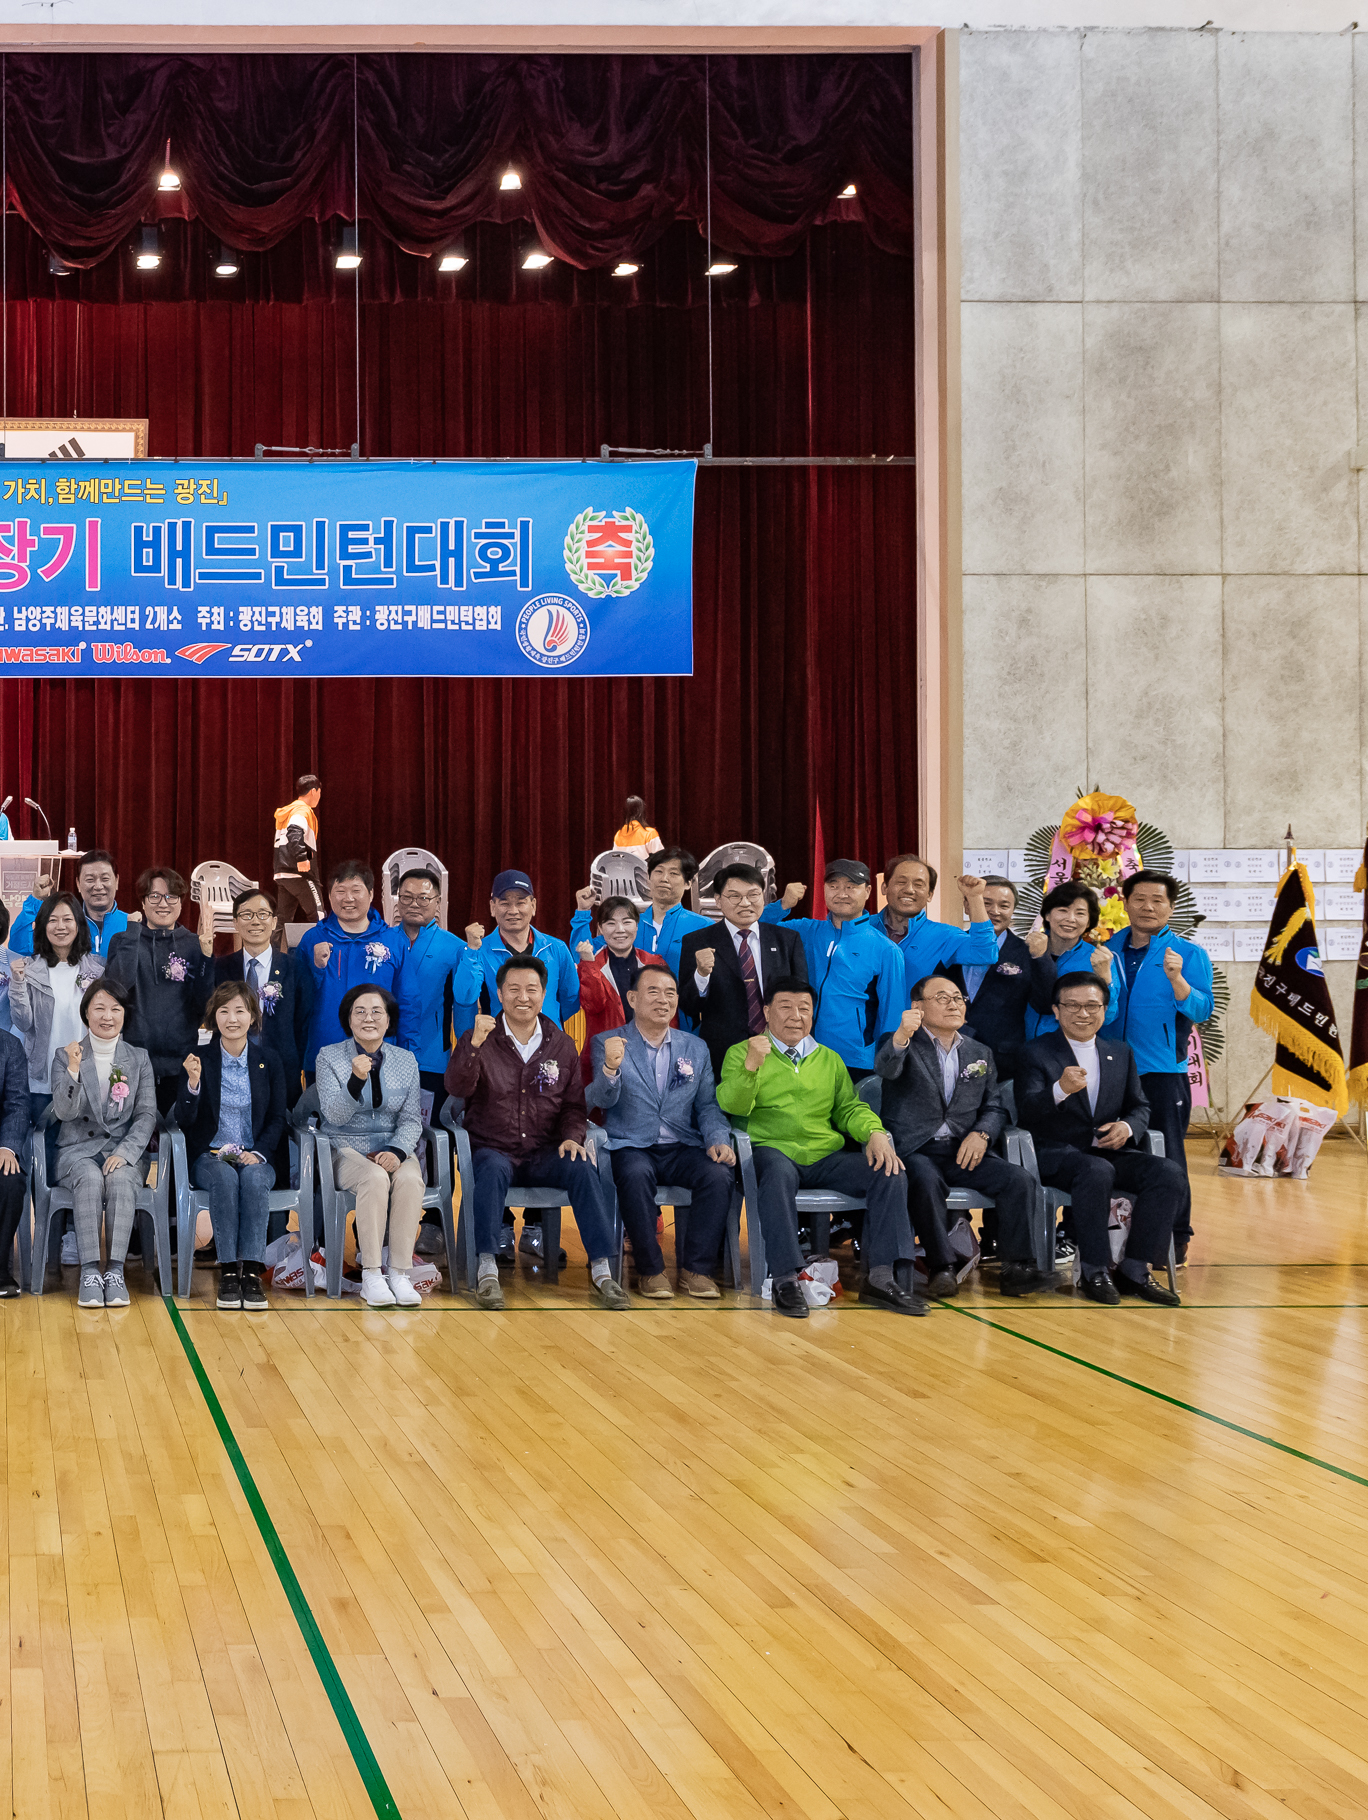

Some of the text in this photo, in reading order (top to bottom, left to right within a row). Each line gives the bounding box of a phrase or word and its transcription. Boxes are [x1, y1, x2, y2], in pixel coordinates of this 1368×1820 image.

[2, 477, 166, 506] 가치,함께만드는
[131, 517, 533, 591] 배드민턴대회
[584, 520, 634, 582] 축
[13, 606, 140, 632] 남양주체육문화센터
[145, 606, 182, 631] 2개소
[197, 606, 224, 631] 주최
[238, 606, 323, 632] 광진구체육회
[333, 606, 362, 631] 주관
[375, 605, 502, 631] 광진구배드민턴협회
[521, 597, 584, 623] PEOPLE LIVING SPORTS
[229, 643, 305, 662] SOTX
